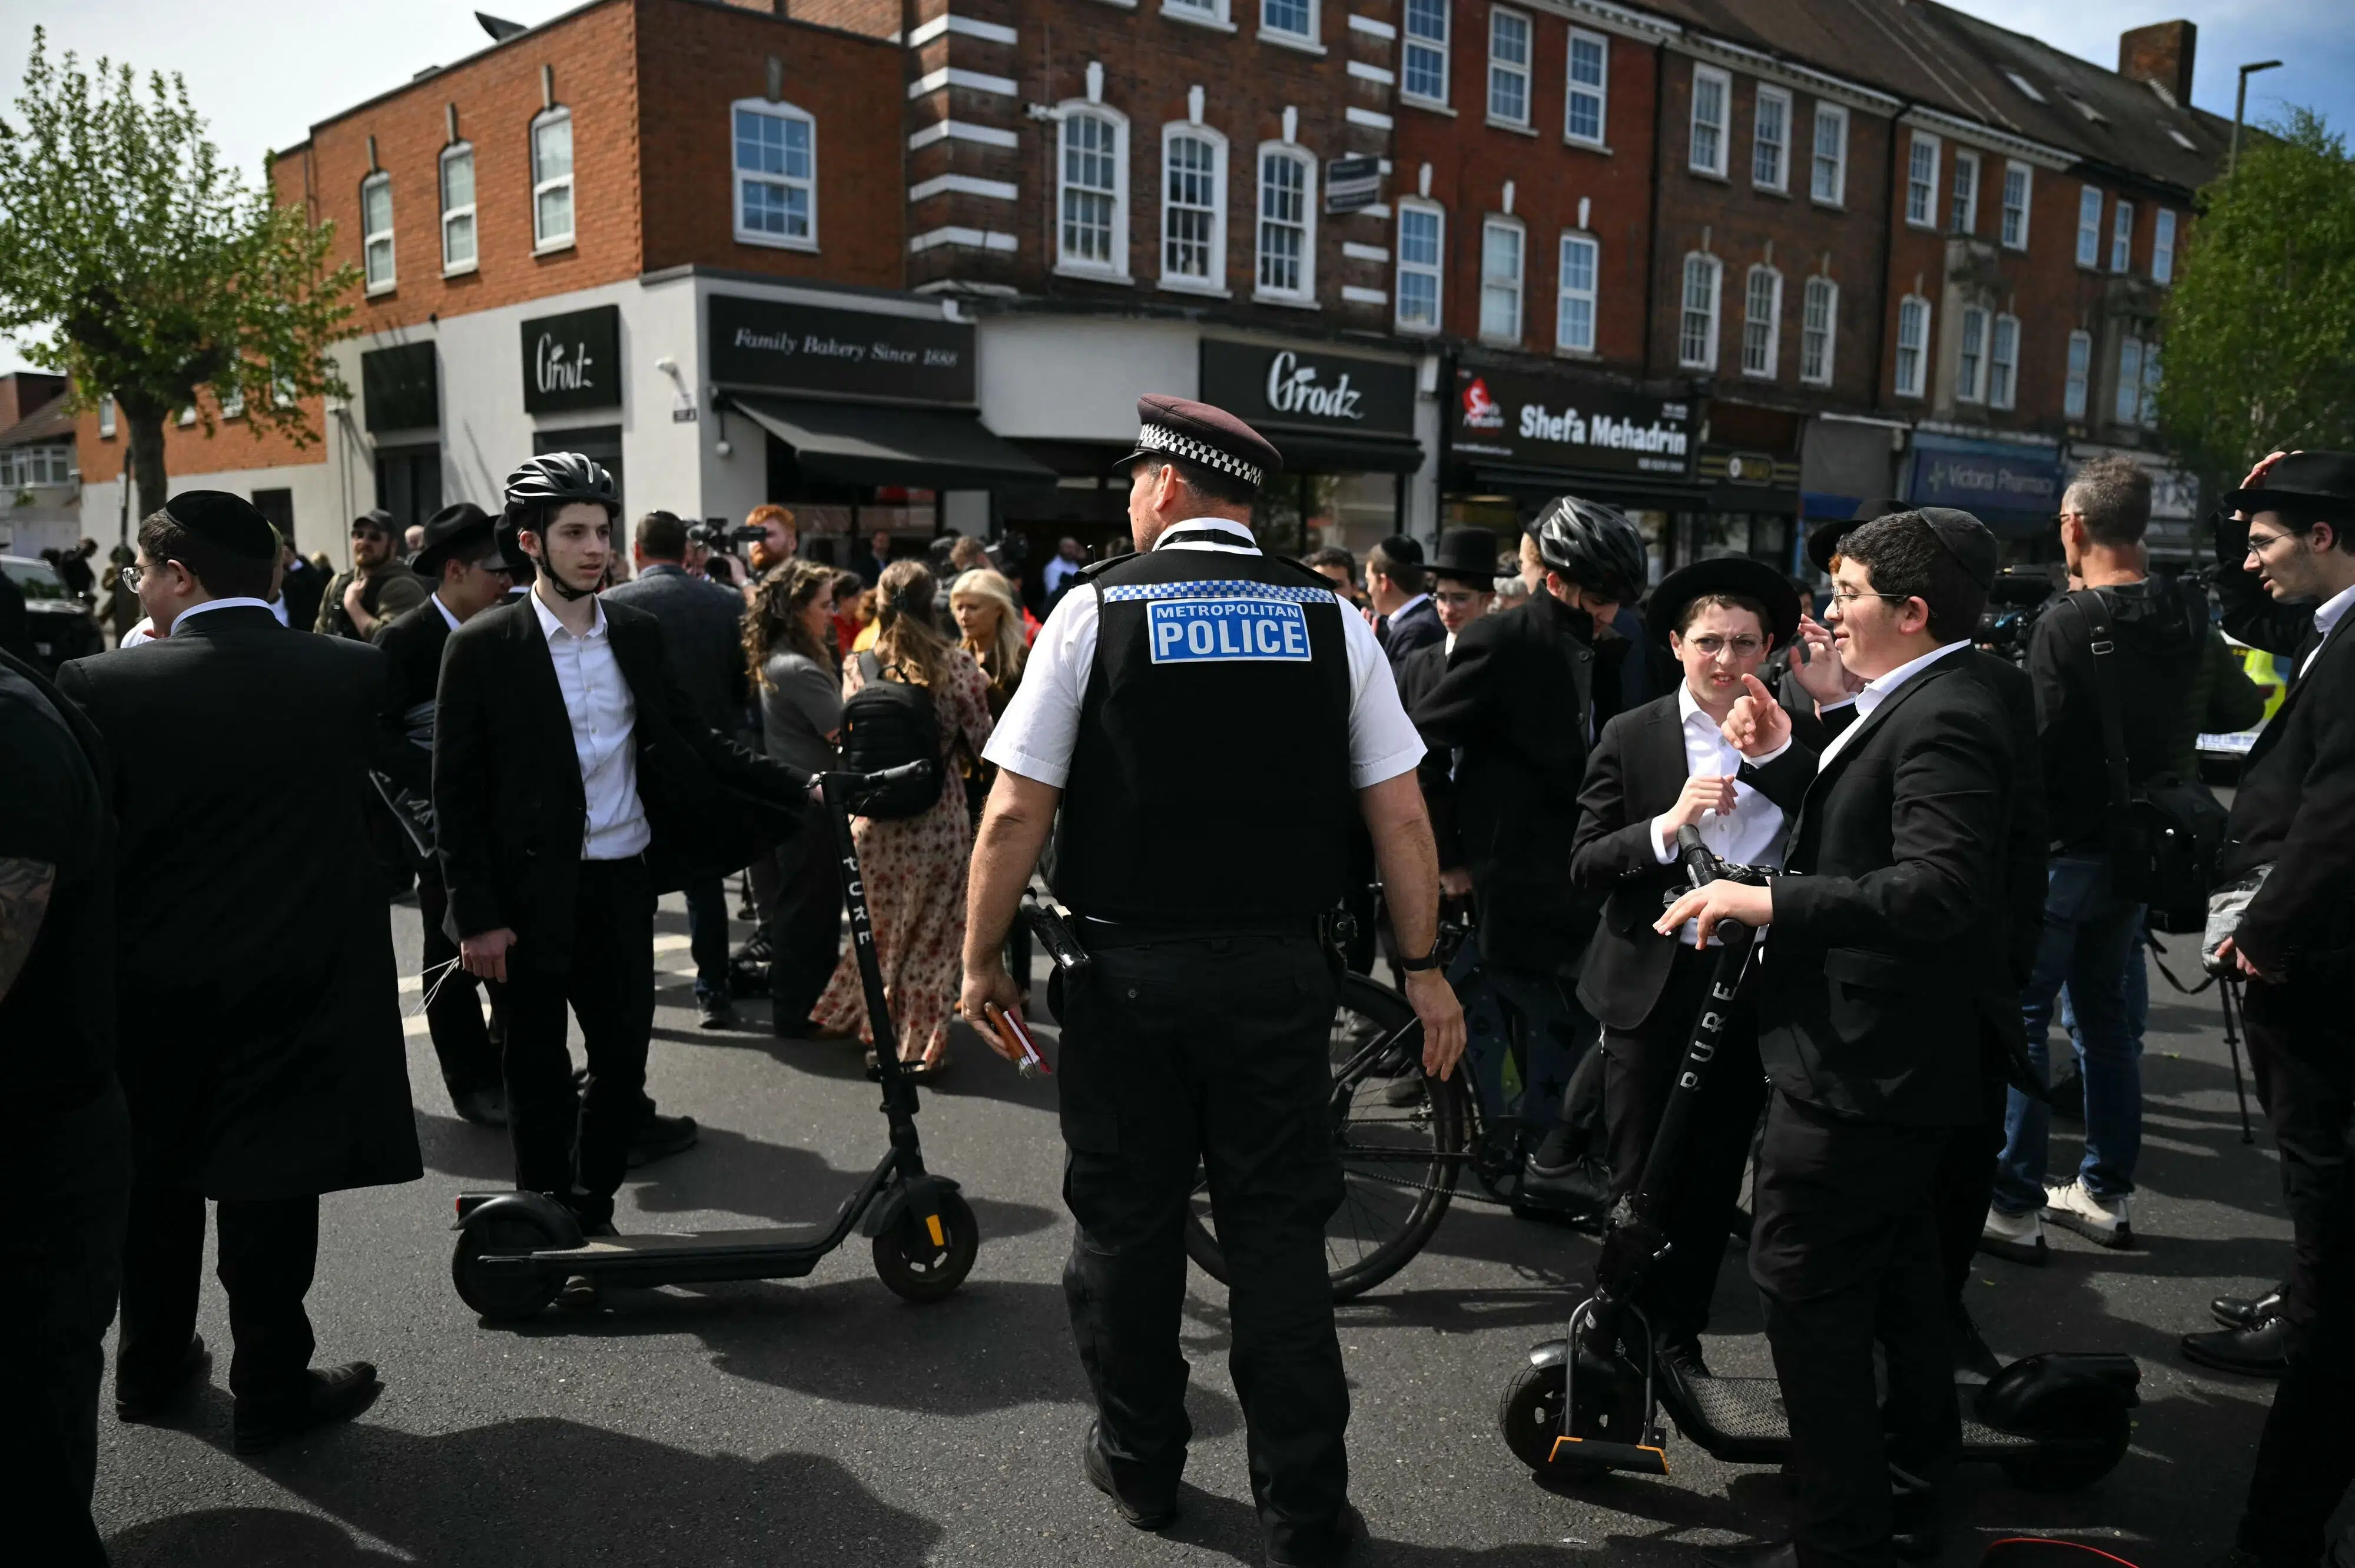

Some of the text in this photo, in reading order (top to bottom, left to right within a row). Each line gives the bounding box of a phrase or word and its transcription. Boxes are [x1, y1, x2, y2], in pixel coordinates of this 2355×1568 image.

[735, 328, 797, 355] Family
[803, 334, 865, 362] Bakery
[871, 341, 917, 363] Since
[1268, 351, 1365, 419] Grodz
[1520, 404, 1585, 443] Shefa
[1591, 414, 1686, 454] Mehadrin
[1157, 604, 1299, 618] METROPOLITAN
[1157, 619, 1305, 656] POLICE
[843, 856, 870, 944] PURE
[1680, 982, 1737, 1091] PURE
